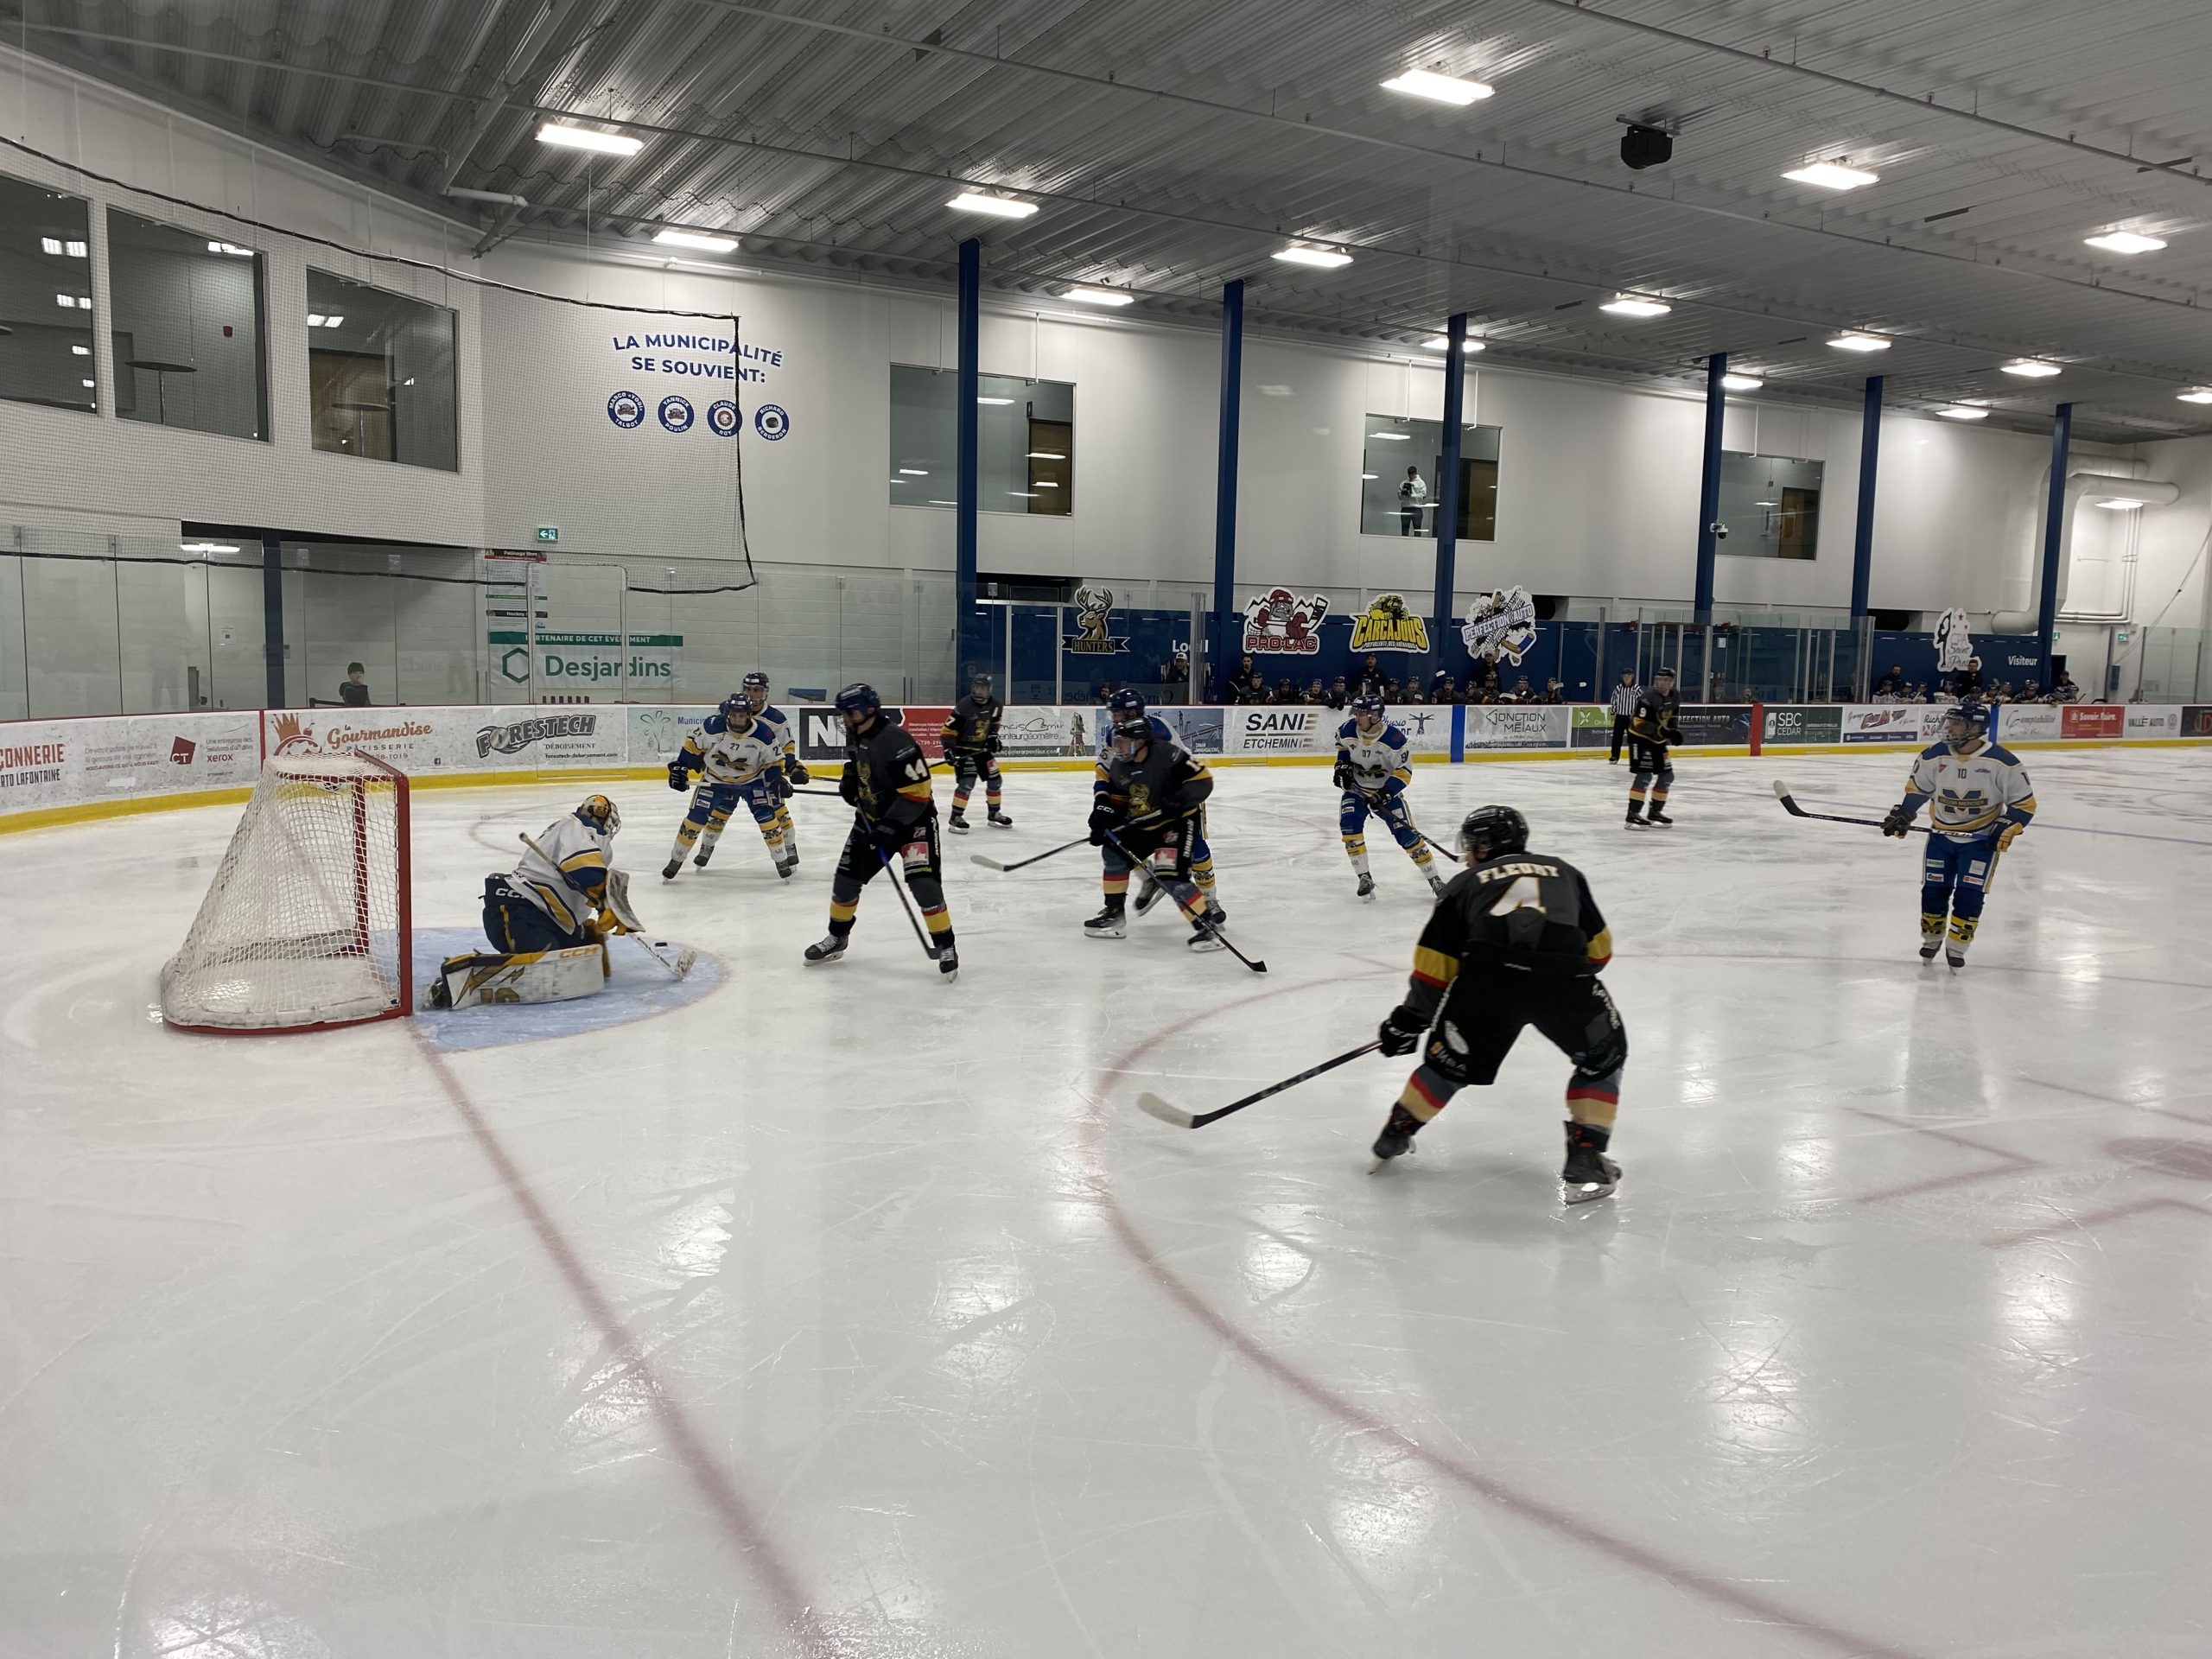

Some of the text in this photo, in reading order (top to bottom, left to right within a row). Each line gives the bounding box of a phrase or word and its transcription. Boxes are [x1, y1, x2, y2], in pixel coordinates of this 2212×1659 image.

[613, 334, 783, 367] LA MUNICIPALITÉ
[632, 356, 766, 383] SE SOUVIENT:
[608, 391, 626, 410] MARCO
[663, 397, 690, 408] YANNICK
[713, 401, 736, 410] CLAUDE
[760, 405, 785, 416] RICHARD
[614, 418, 639, 428] TALBOT
[664, 422, 689, 432] POULIN
[757, 426, 787, 439] BERGERON
[1465, 605, 1533, 640] PERFECTION AUTO
[1353, 616, 1428, 650] CARCAJOUS
[1074, 640, 1114, 652] HUNTERS
[2008, 656, 2037, 666] Visiteur
[545, 655, 671, 681] Desjardins
[1486, 709, 1546, 726] JONCTION
[1777, 712, 1802, 727] SBC
[1503, 721, 1547, 733] MÉTAUX
[1777, 727, 1802, 736] CEDAR
[327, 721, 433, 750] Gourmandise
[476, 715, 596, 759] FORESTECH
[729, 742, 740, 752] 27
[1243, 738, 1299, 749] ETCHEMIN
[172, 753, 189, 764] CT
[207, 753, 233, 762] xerox
[16, 769, 60, 785] LAFONTAINE
[1957, 768, 1967, 779] 10
[1476, 863, 1560, 885] FLEURY
[1489, 875, 1547, 917] 4
